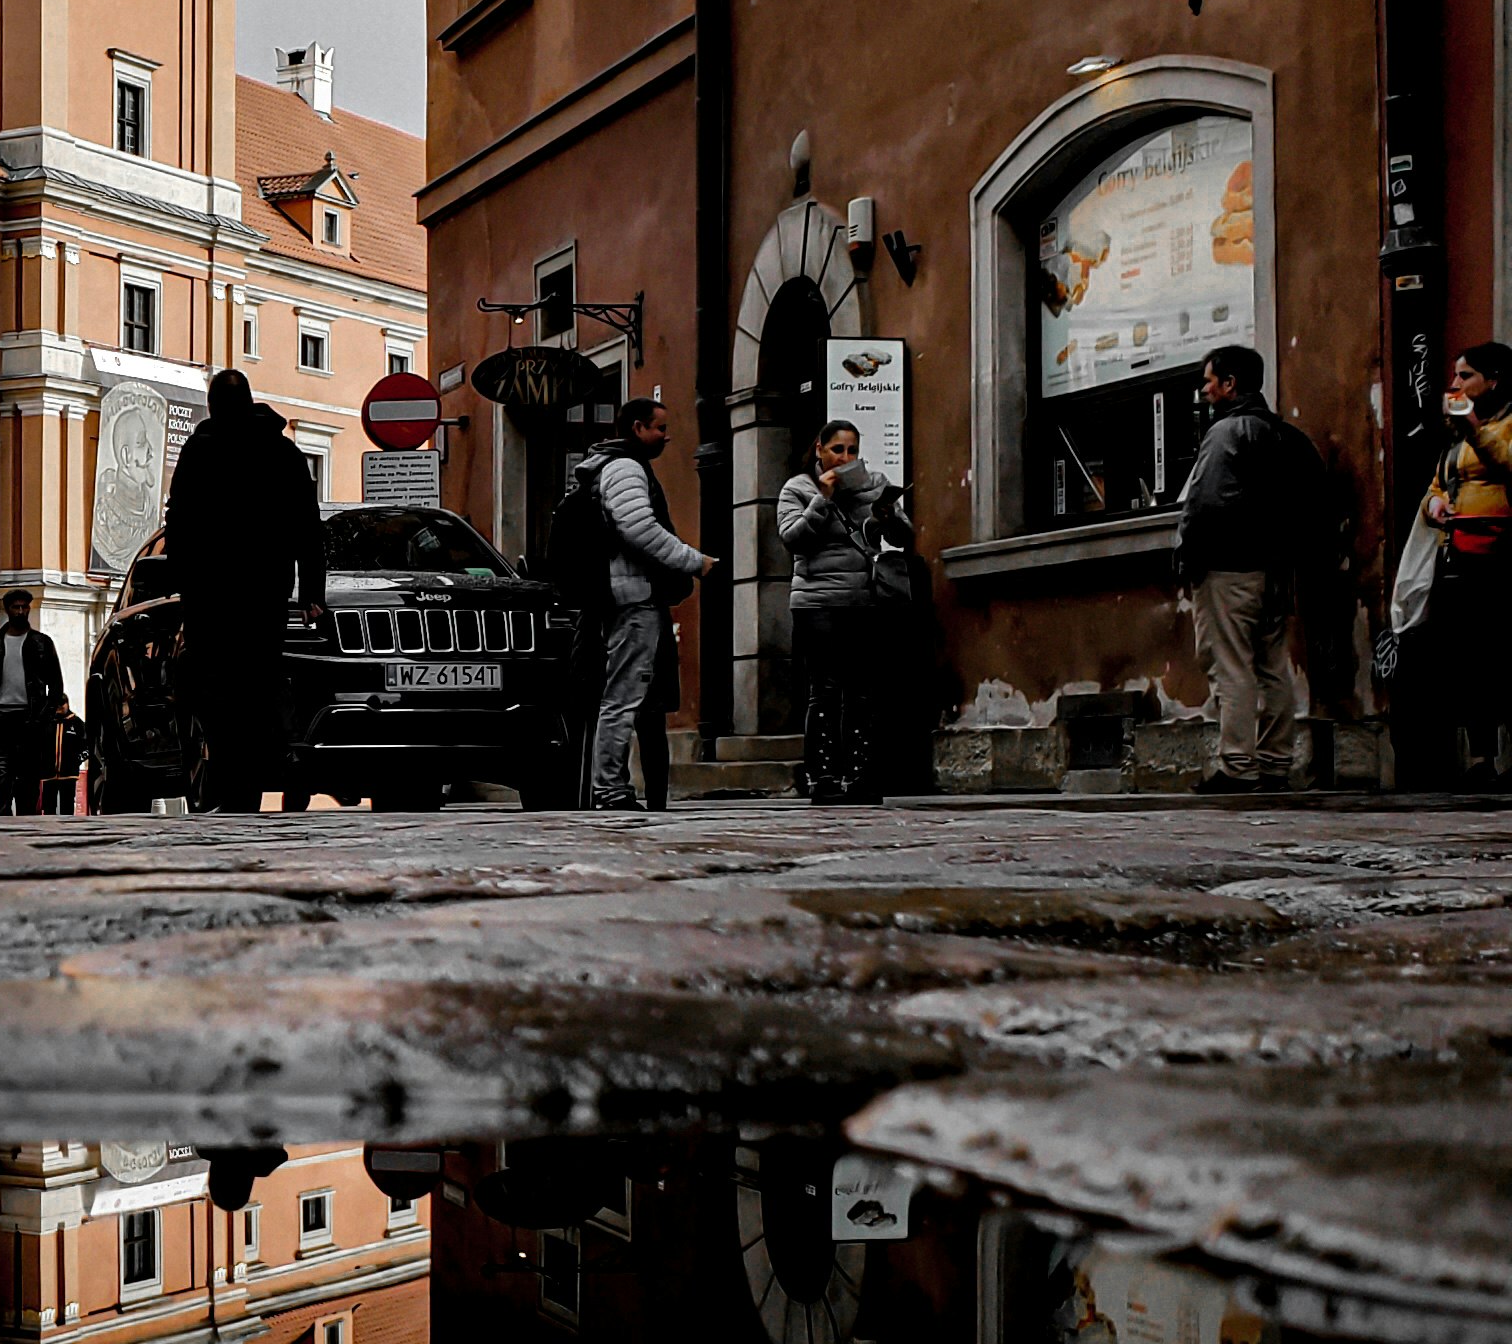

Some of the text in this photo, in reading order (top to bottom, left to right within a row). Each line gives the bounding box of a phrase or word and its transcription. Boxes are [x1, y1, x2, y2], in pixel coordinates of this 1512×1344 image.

[830, 382, 900, 394] Gofry Belgijskie
[169, 405, 192, 419] POCZET
[416, 592, 452, 602] Jeep
